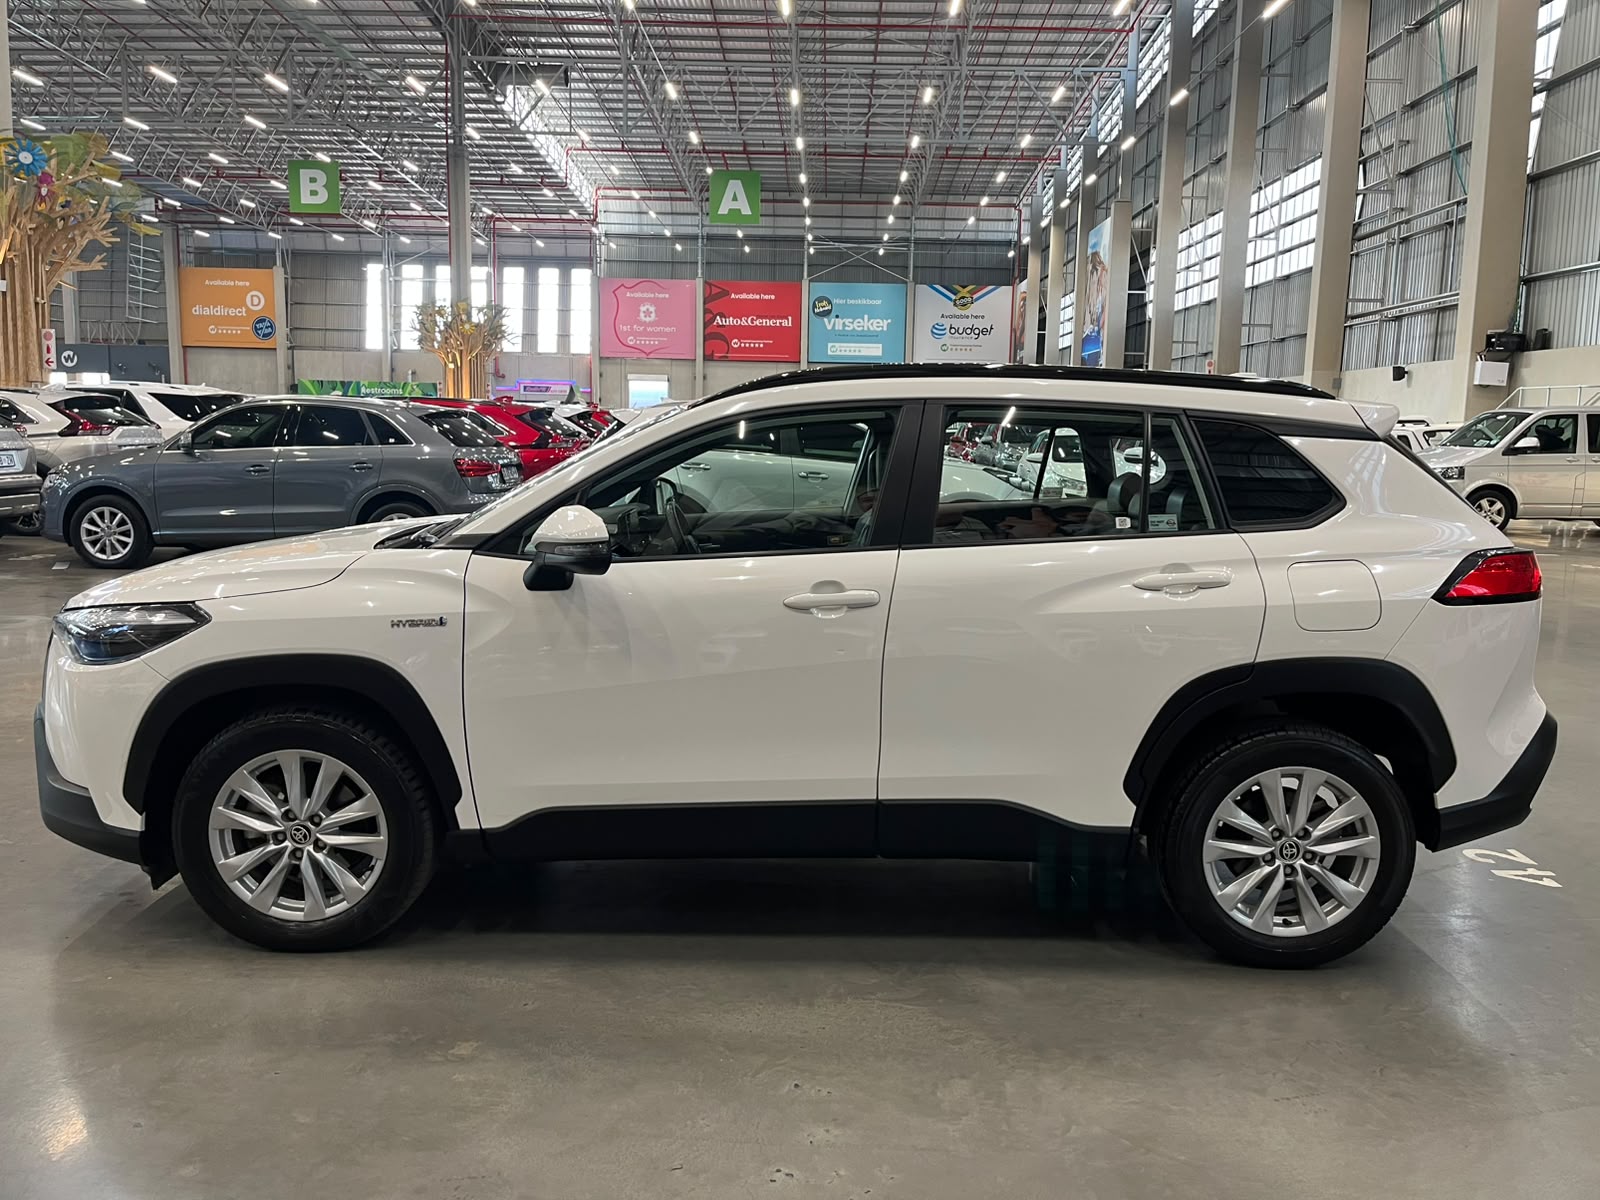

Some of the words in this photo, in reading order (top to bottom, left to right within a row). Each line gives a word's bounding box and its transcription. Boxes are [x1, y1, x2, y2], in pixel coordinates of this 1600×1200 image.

[300, 169, 328, 204] B
[718, 180, 752, 214] A
[250, 294, 261, 307] D
[192, 304, 247, 316] dialdirect
[713, 315, 792, 327] Auto&General
[823, 314, 891, 331] virseker
[619, 324, 631, 332] 1st
[633, 324, 644, 332] for
[949, 323, 994, 340] budget
[62, 352, 77, 365] W
[361, 386, 403, 395] Restrooms
